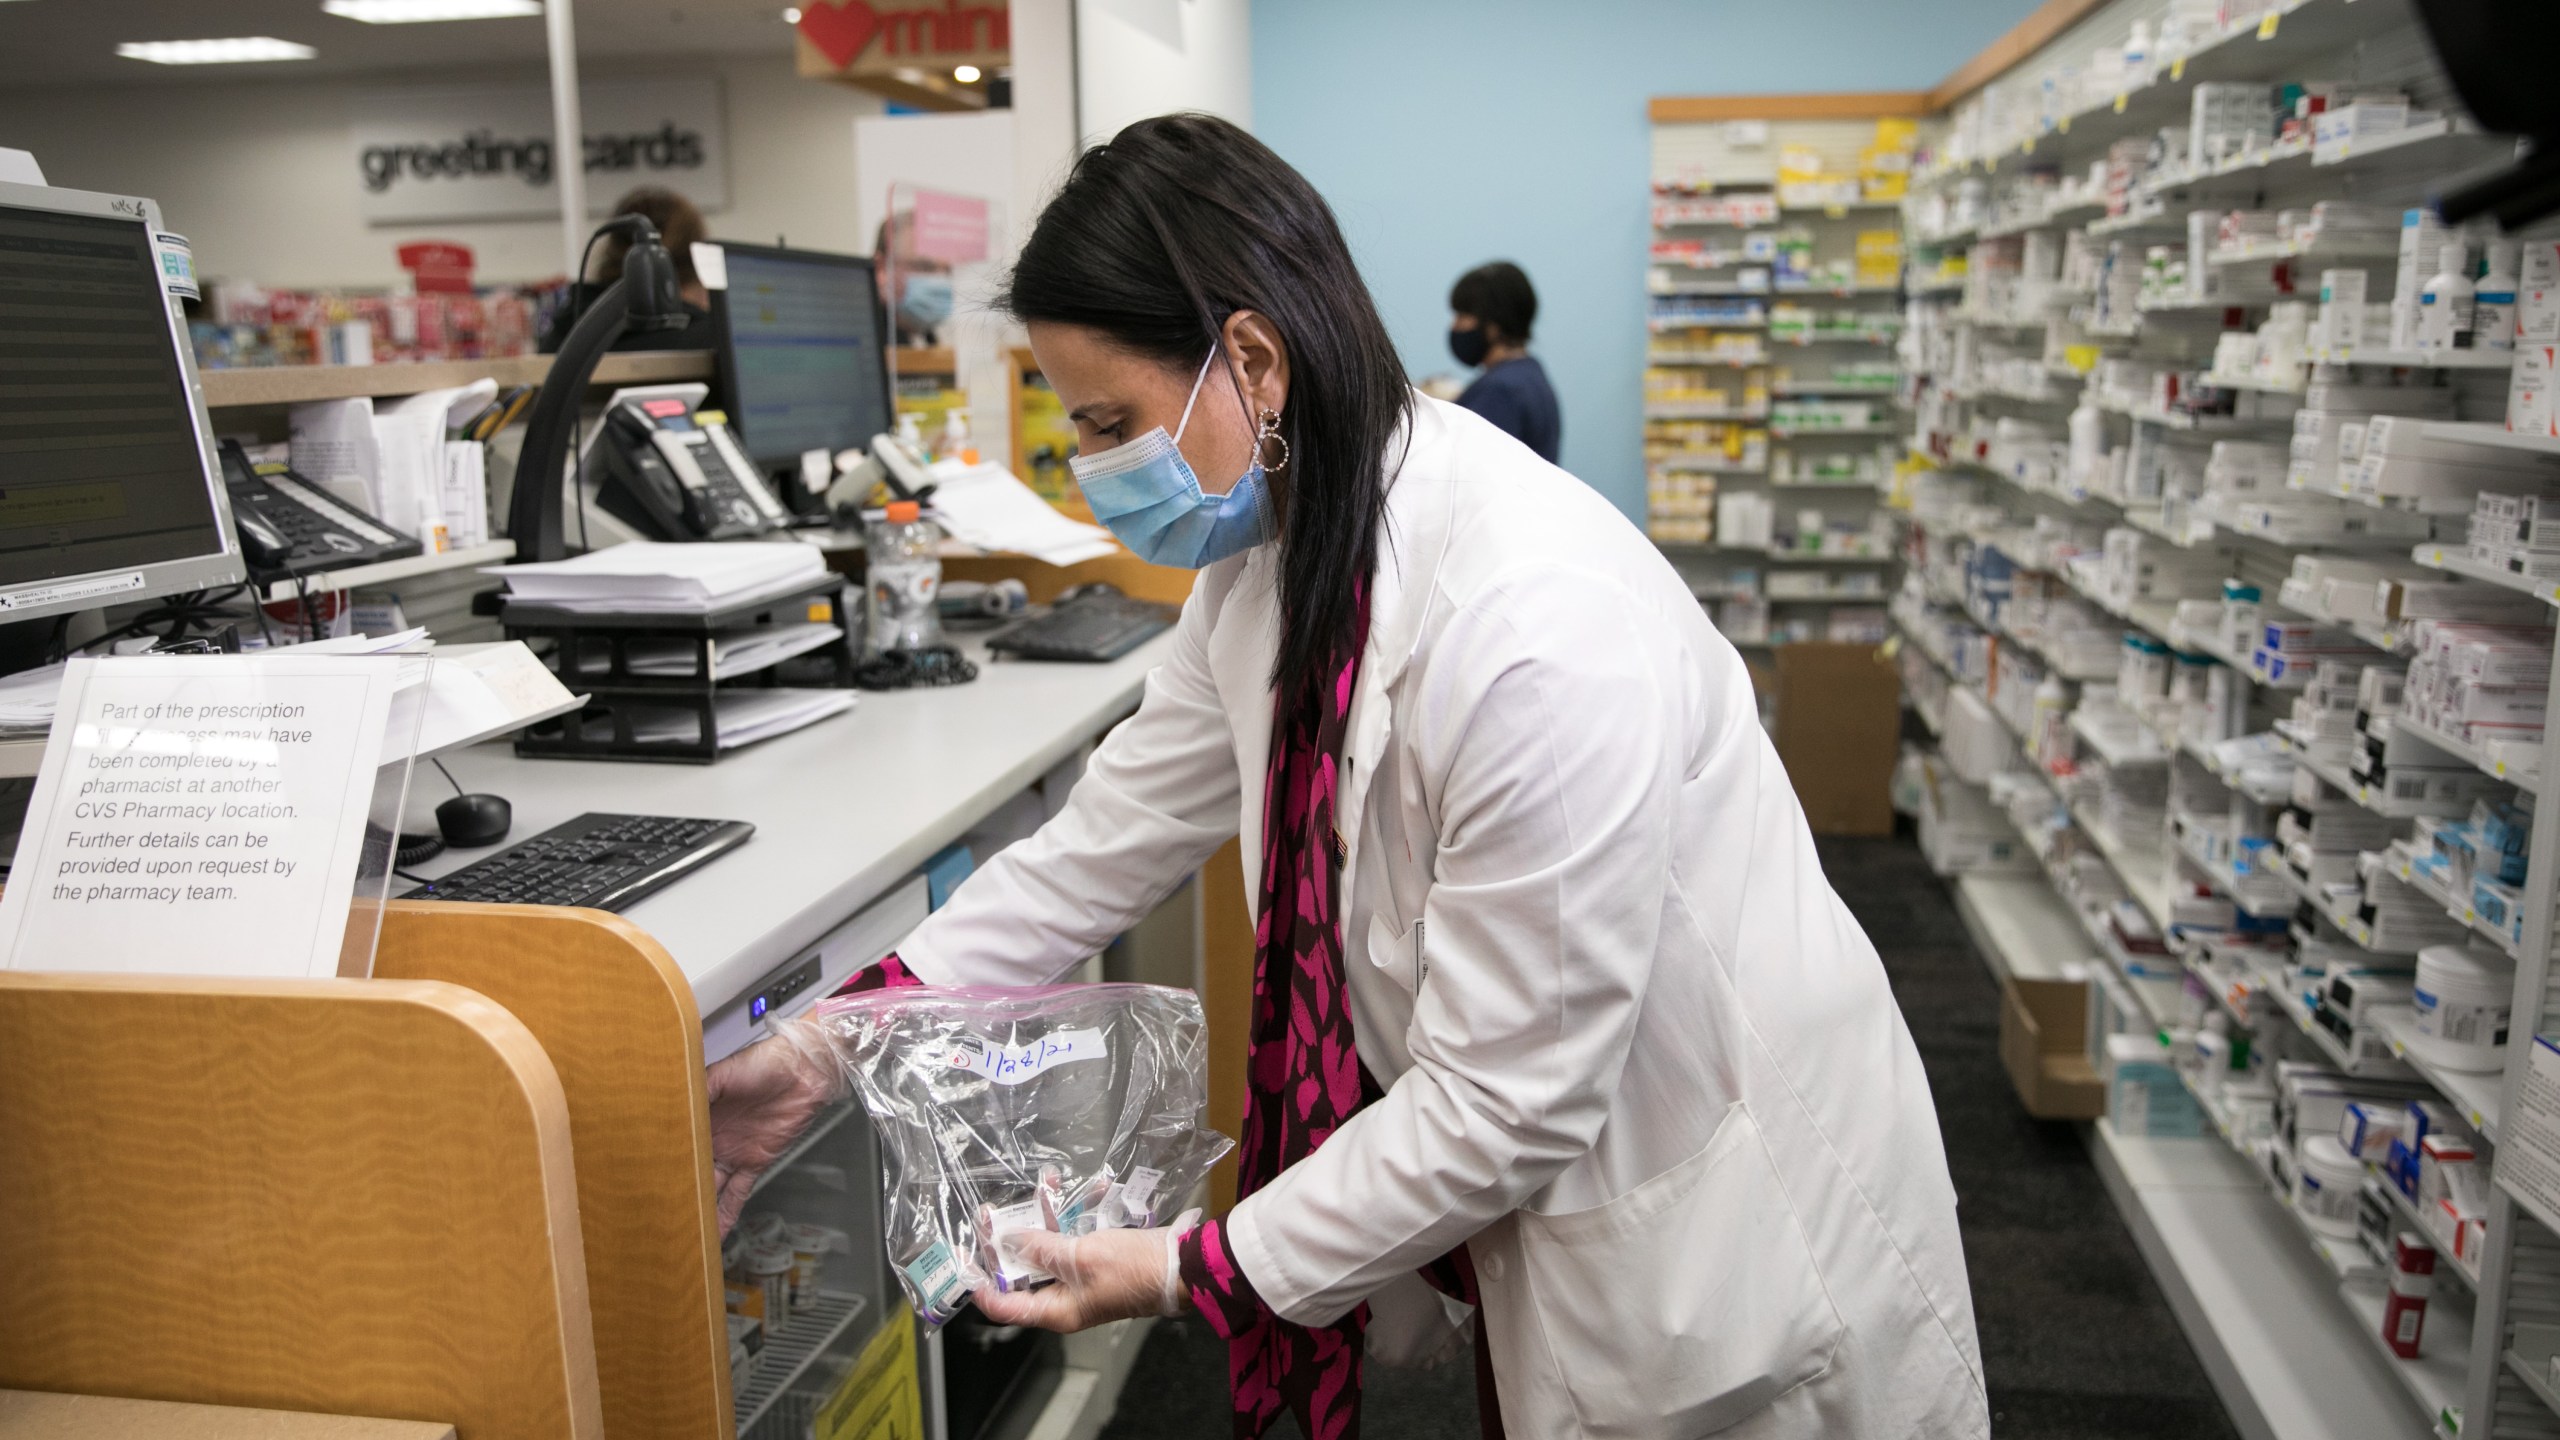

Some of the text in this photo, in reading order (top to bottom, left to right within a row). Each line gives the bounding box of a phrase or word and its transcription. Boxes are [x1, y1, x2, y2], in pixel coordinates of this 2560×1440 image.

[361, 127, 553, 191] greeting
[101, 702, 305, 722] Part of the prescription
[268, 727, 313, 744] have
[88, 753, 134, 769] been
[138, 752, 233, 771] completed
[80, 777, 282, 797] pharmacist at another
[74, 802, 299, 823] CVS Pharmacy location.
[66, 831, 269, 848] Further details can be
[58, 857, 297, 878] provided upon request by
[52, 883, 238, 904] the pharmacy team.
[985, 1040, 1072, 1078] 1/28/21
